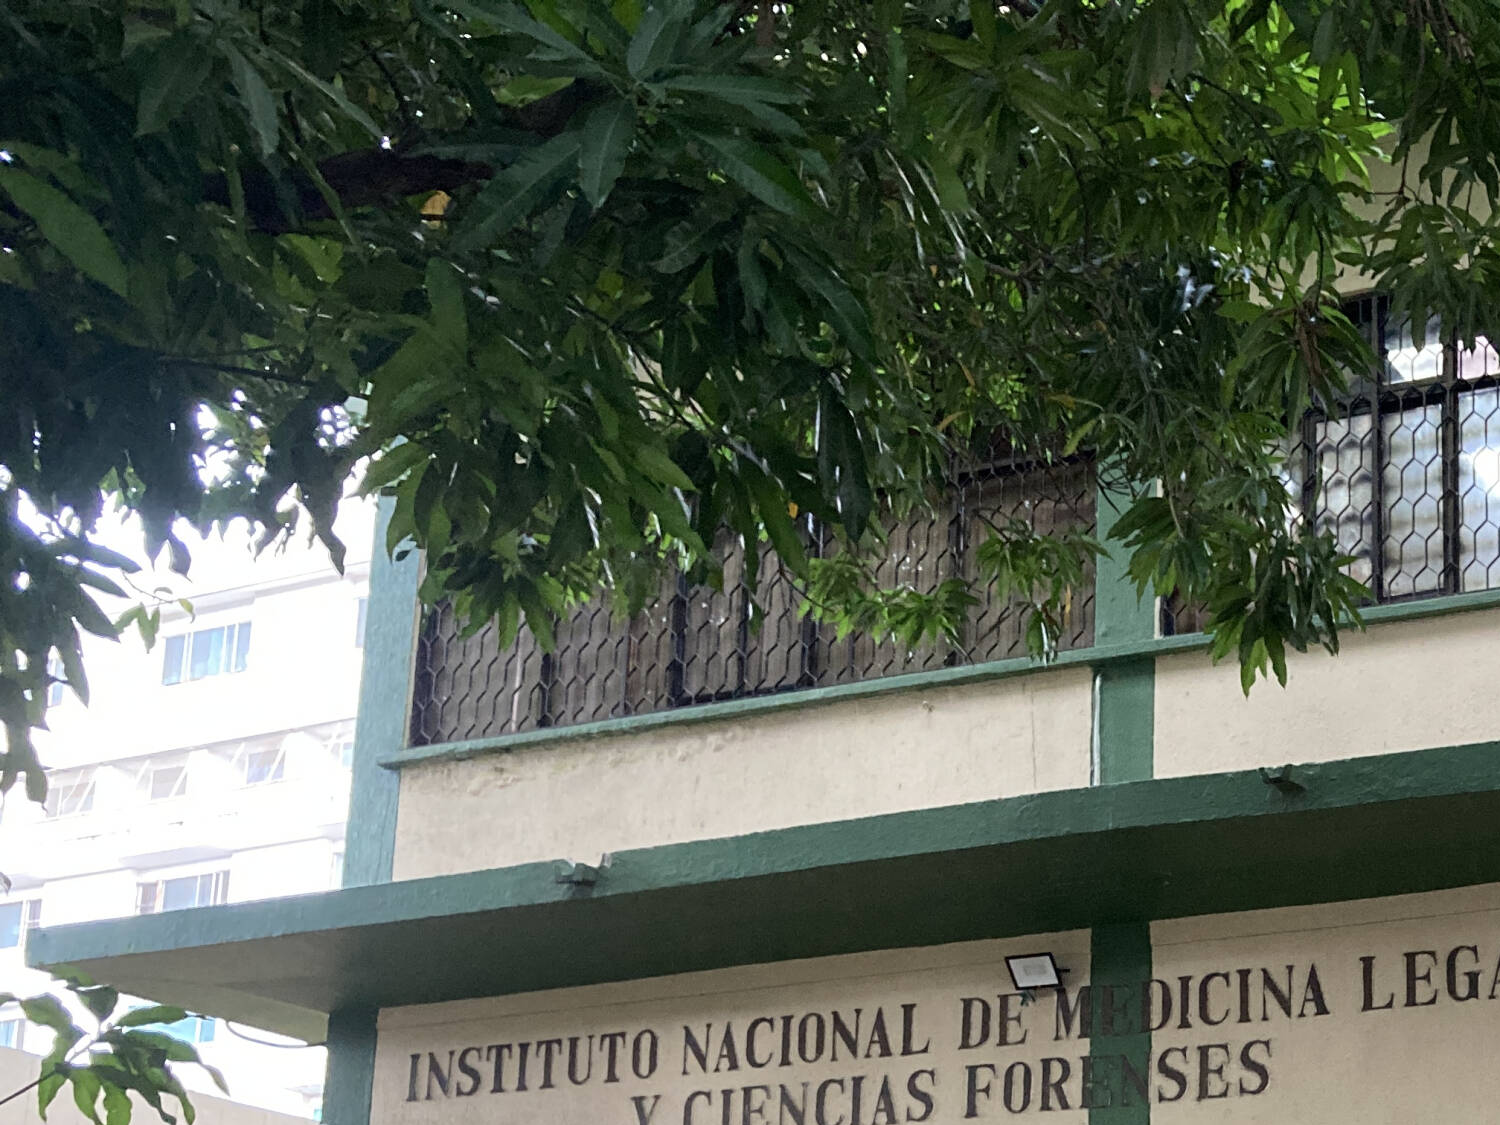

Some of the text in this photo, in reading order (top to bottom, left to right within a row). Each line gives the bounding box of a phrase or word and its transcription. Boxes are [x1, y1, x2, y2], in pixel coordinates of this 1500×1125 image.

[405, 1028, 661, 1101] INSTITUTO
[681, 1003, 931, 1076] NACIONAL
[958, 995, 1029, 1050] DE
[1053, 963, 1330, 1043] MEDICINA
[963, 1039, 1274, 1119] FORENSES
